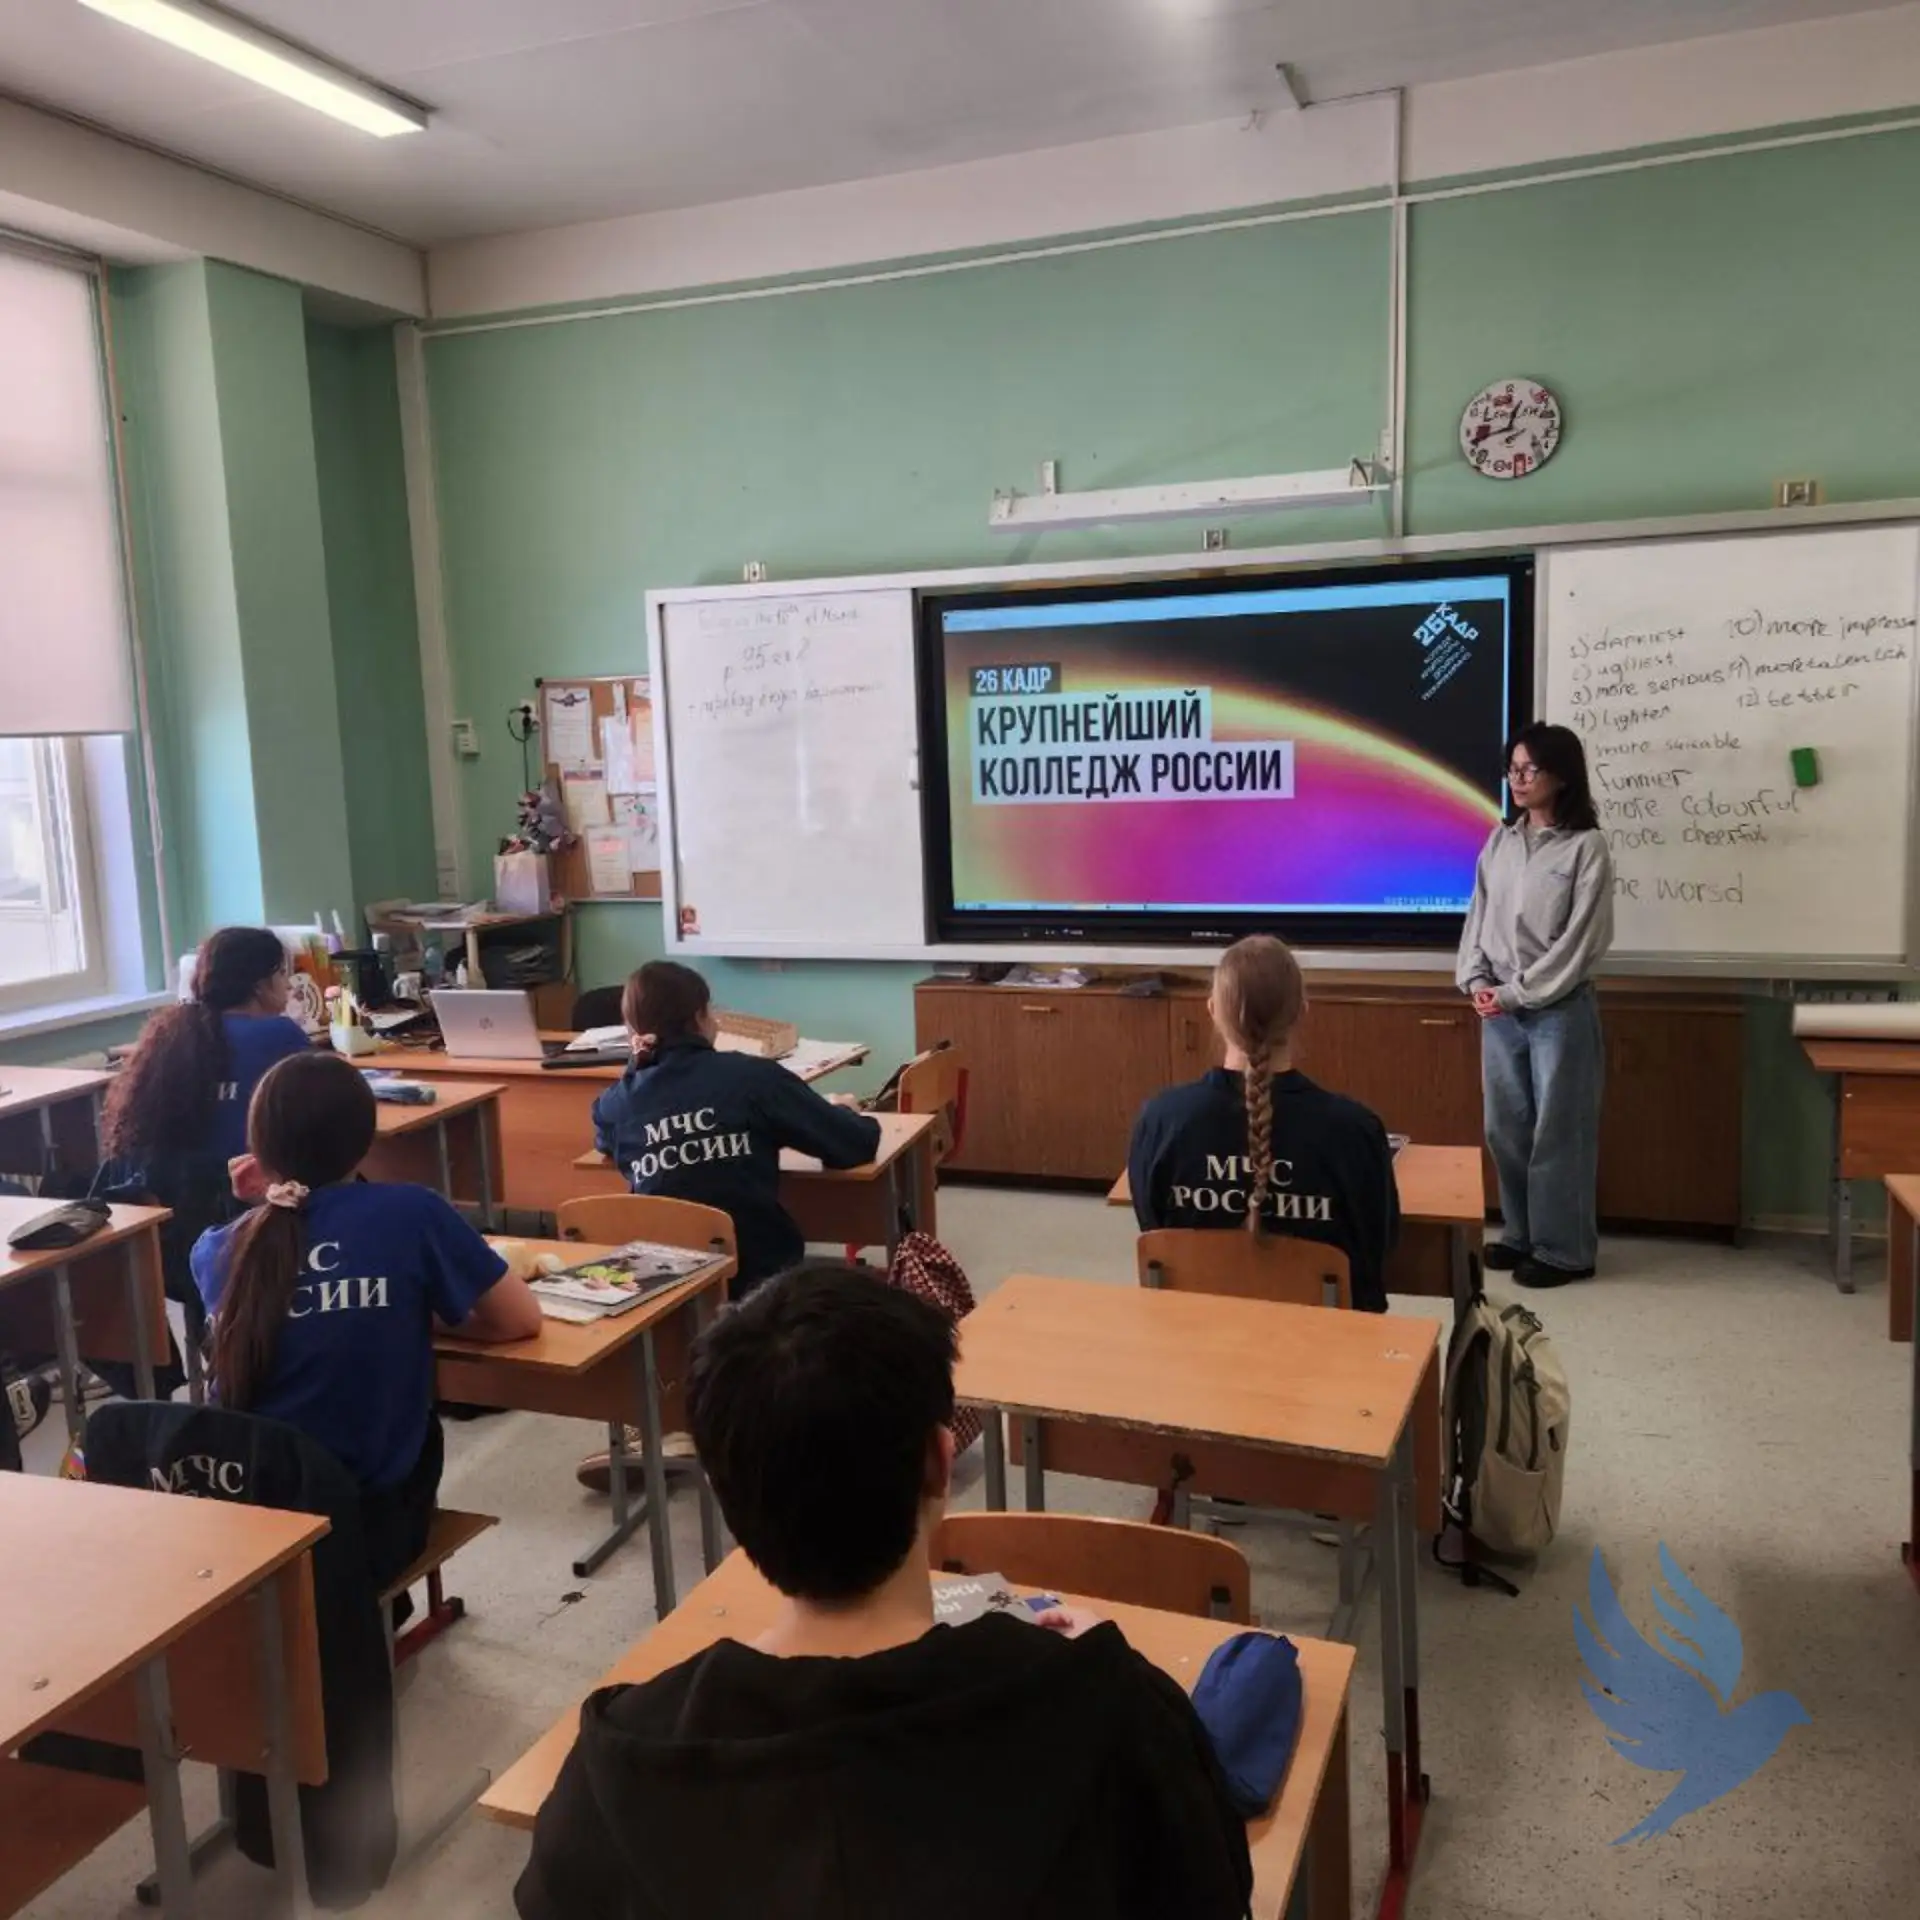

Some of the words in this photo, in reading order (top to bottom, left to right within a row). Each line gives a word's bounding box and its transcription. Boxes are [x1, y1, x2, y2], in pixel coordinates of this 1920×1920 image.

[974, 669, 999, 693] 26
[1001, 667, 1052, 692] КАДР
[1595, 684, 1638, 700] more
[977, 689, 1202, 745] КРУПНЕЙШИЙ
[979, 752, 1142, 799] КОЛЛЕДЖ
[1150, 749, 1283, 793] РОССИИ
[643, 1107, 718, 1147] МЧС
[631, 1131, 752, 1184] РОССИИ
[151, 1454, 243, 1493] МЧС
